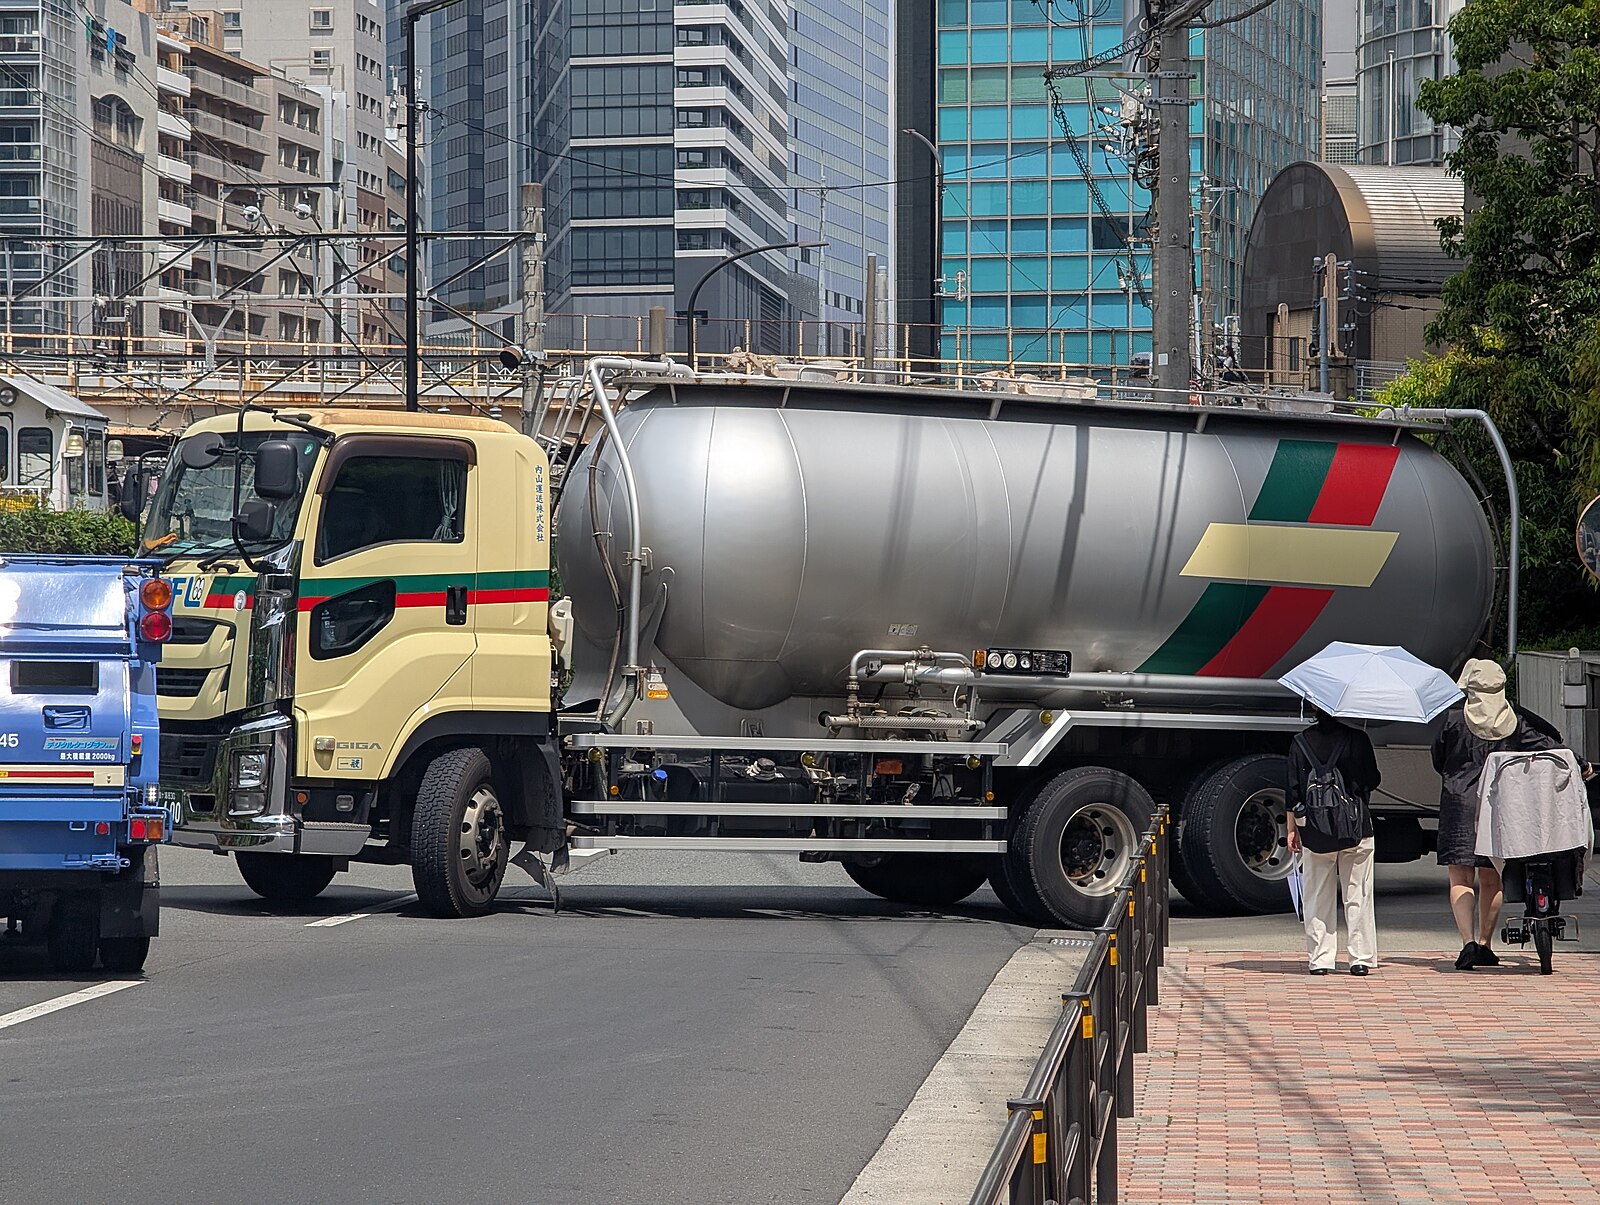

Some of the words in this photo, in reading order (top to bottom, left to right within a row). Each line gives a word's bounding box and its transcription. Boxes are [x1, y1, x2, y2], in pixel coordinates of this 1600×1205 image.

[535, 465, 544, 542] 内山運送株式会社
[161, 576, 201, 608] FL
[336, 742, 382, 750] GIGA
[92, 753, 115, 761] 2000kg
